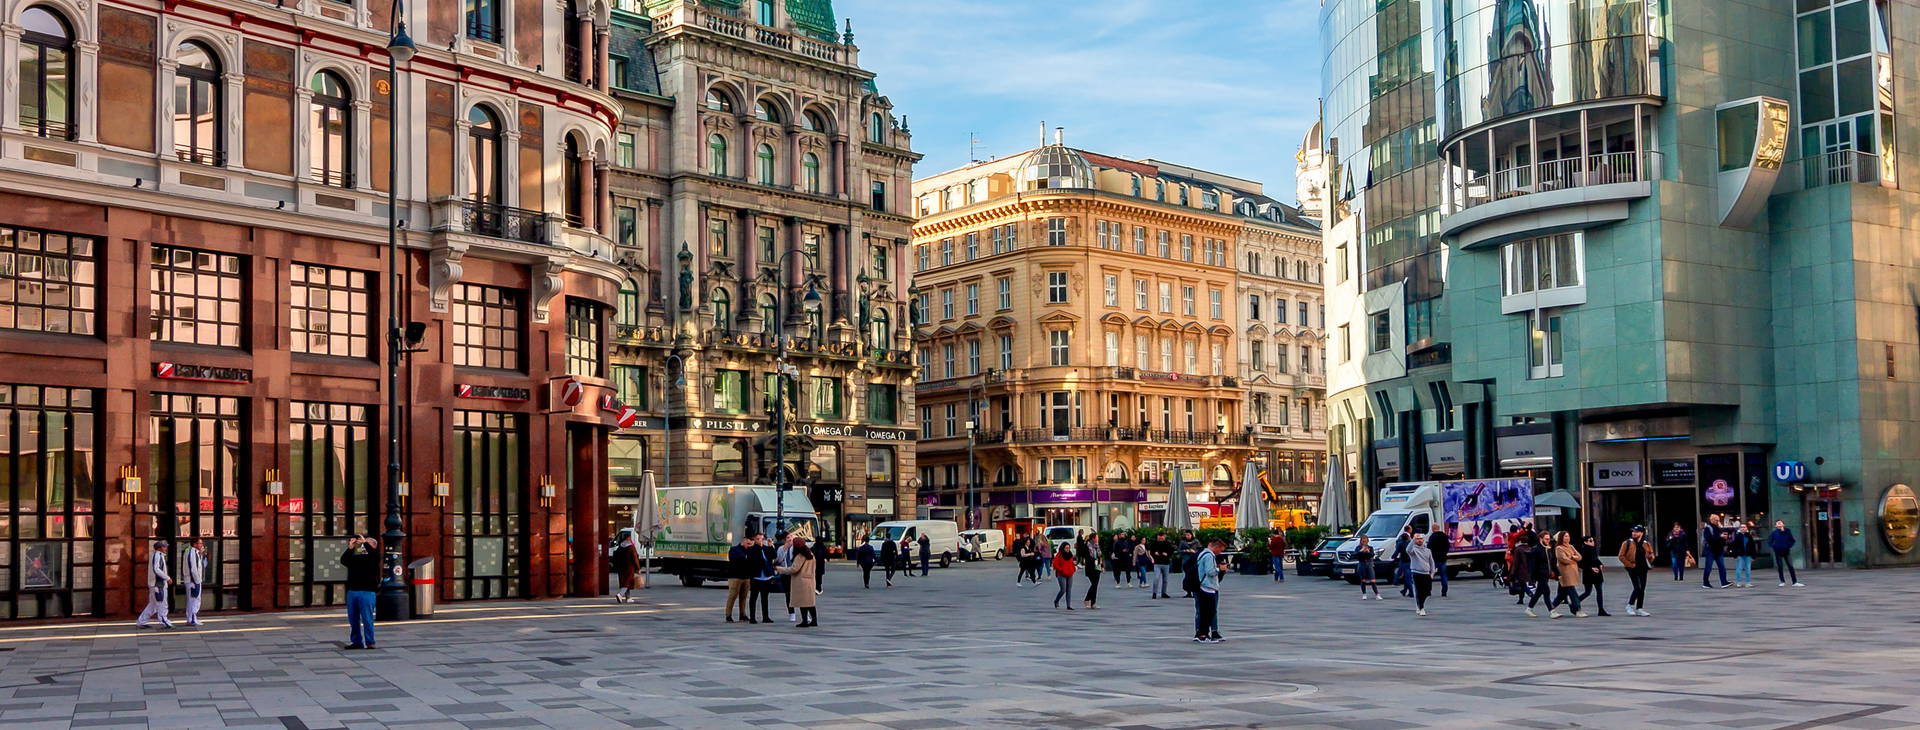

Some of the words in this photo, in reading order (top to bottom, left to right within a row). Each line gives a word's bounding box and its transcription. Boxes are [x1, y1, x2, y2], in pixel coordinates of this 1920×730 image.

[706, 420, 748, 430] PILSTL
[813, 427, 841, 436] OMEGA
[870, 431, 896, 440] OMEGA
[1776, 465, 1790, 480] U
[1794, 464, 1804, 479] U
